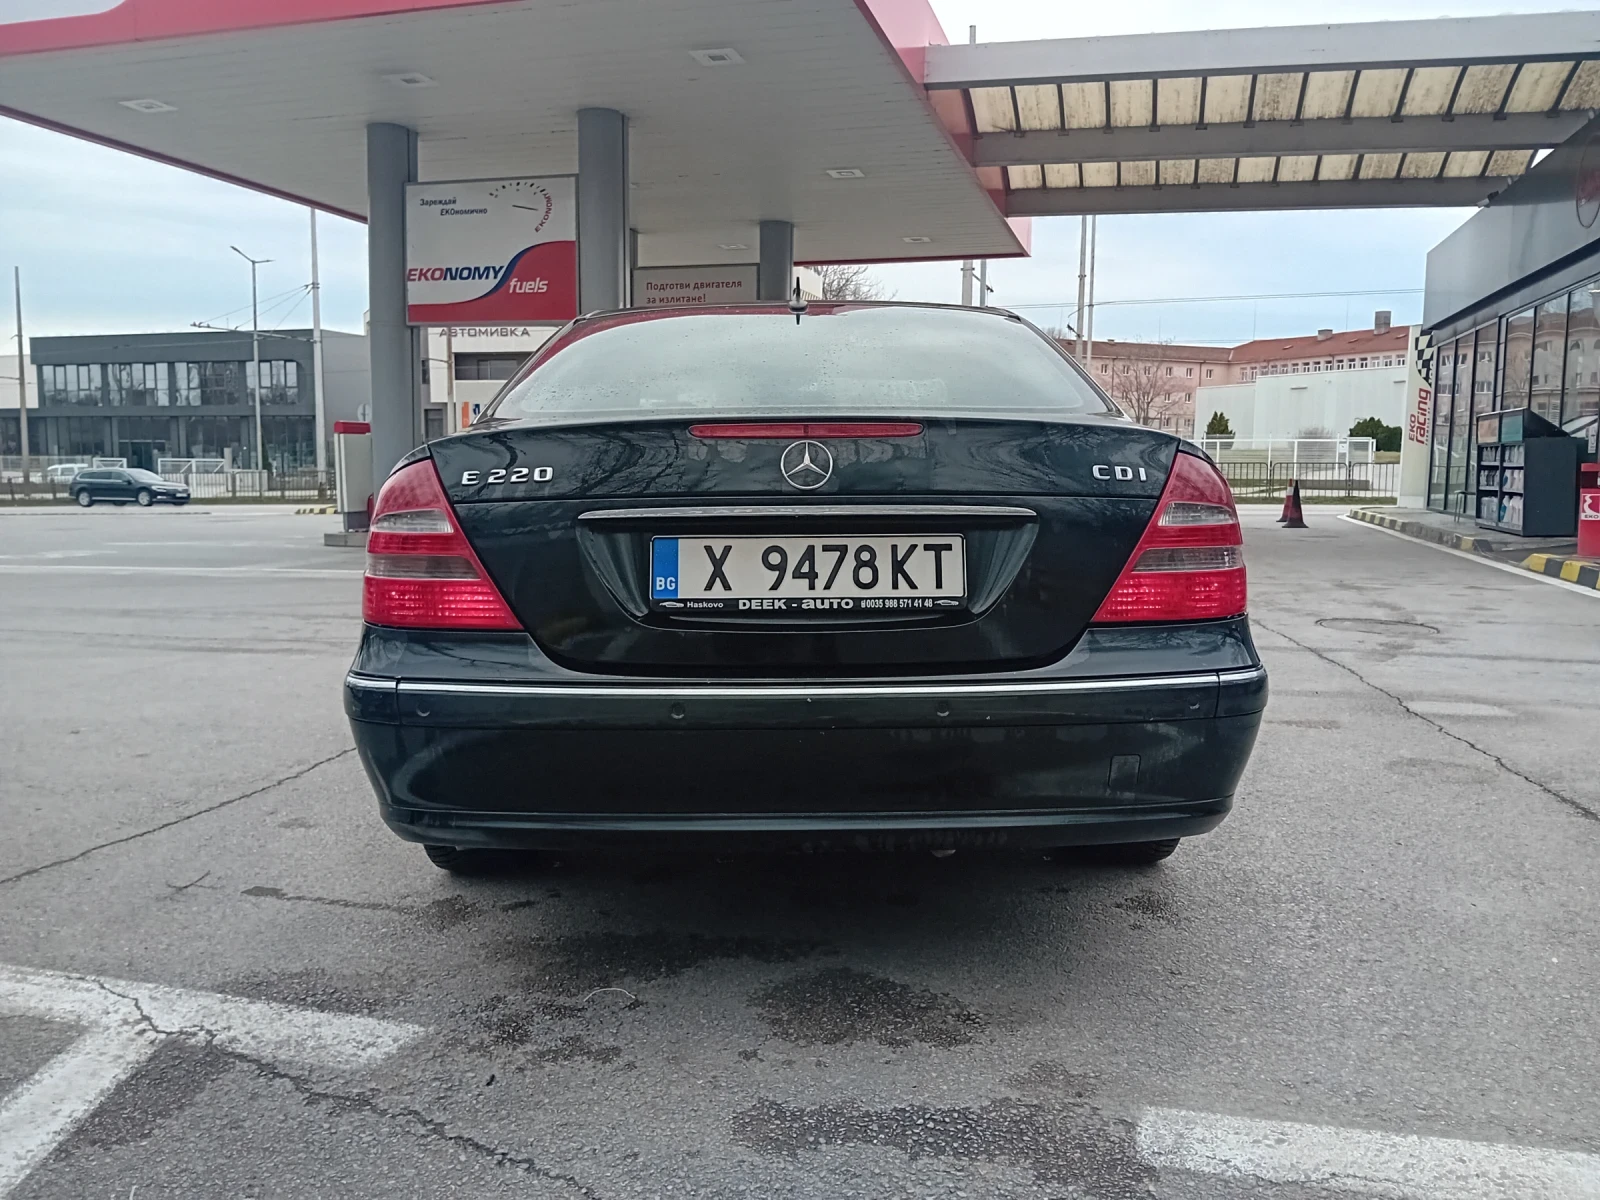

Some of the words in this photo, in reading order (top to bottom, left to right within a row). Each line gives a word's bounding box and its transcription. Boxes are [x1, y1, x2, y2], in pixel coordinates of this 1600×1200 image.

[419, 196, 457, 207] Зареждай
[440, 208, 488, 216] ЕКОномично
[534, 192, 553, 233] EKONOMY
[407, 265, 505, 282] EKONOMY
[509, 277, 549, 294] fuels
[646, 281, 691, 292] Подготви
[693, 280, 742, 290] двигателя
[646, 296, 657, 304] за
[659, 294, 706, 304] излитане!
[439, 327, 530, 338] АВТОМИВКА
[1415, 387, 1432, 445] racing
[1408, 413, 1417, 442] EKO
[461, 470, 481, 485] E
[487, 466, 554, 484] 220
[1092, 464, 1147, 482] CDI
[703, 545, 733, 591] X
[656, 577, 676, 590] BG
[738, 599, 787, 610] DEEK
[866, 599, 883, 608] 0035
[885, 599, 898, 608] 988
[899, 599, 912, 608] 571
[913, 599, 923, 608] 41
[924, 599, 933, 607] 48
